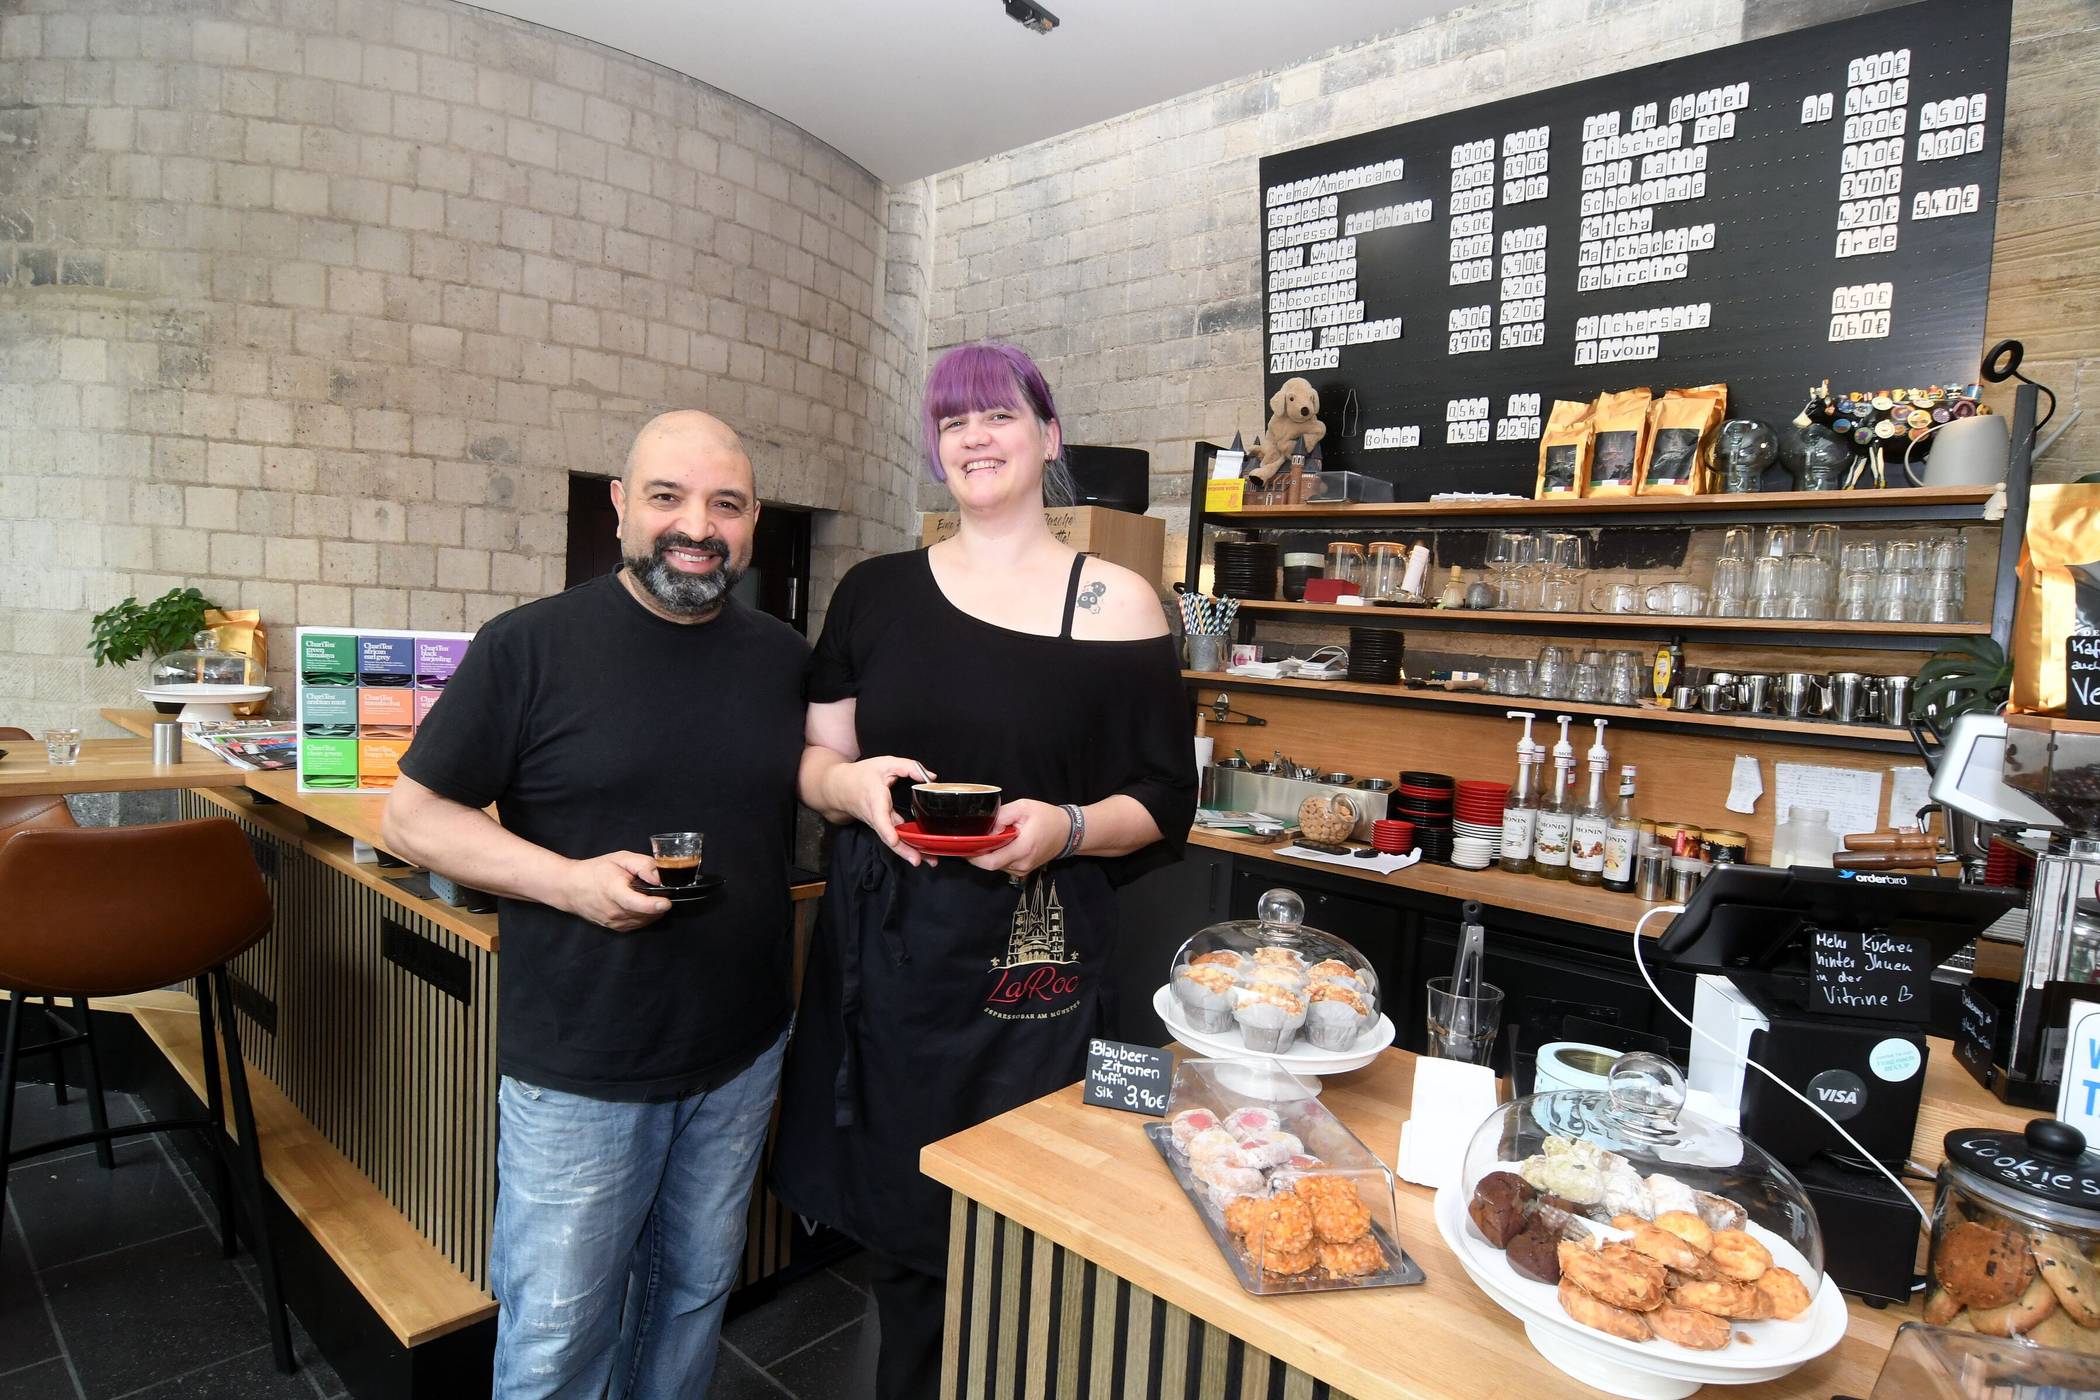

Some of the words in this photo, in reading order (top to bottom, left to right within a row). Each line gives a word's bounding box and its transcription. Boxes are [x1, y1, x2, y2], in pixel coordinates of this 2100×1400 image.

[1850, 57, 1906, 83] 3,90€
[1584, 122, 1618, 138] Tee
[1634, 111, 1656, 126] im
[1671, 90, 1744, 119] Beutel
[1804, 101, 1830, 119] ab
[1848, 86, 1905, 111] 4,40€
[1585, 134, 1680, 156] frischer
[1696, 123, 1731, 139] Tee
[1584, 164, 1628, 182] Chai
[1644, 155, 1704, 175] Latte
[1267, 166, 1402, 204] Crema/Americano
[1583, 181, 1704, 212] Schokolade
[1268, 203, 1337, 226] Espresso
[1269, 226, 1337, 248] Espresso
[1345, 207, 1431, 232] Macchiato
[1581, 218, 1651, 238] Matcha
[1580, 232, 1713, 262] Matchaccino
[1839, 233, 1896, 253] free
[1270, 252, 1302, 268] Flat
[1311, 243, 1354, 261] White
[1270, 266, 1355, 288] Cappuccino
[1580, 263, 1687, 289] Babiccino
[1270, 286, 1356, 309] Chococcino
[1270, 307, 1363, 330] Milchkaffee
[1577, 311, 1707, 336] Milchersatz
[1270, 335, 1312, 352] Latte
[1320, 322, 1401, 345] Macchiato
[1450, 334, 1490, 353] 3,90€
[1501, 327, 1543, 347] 5,90€
[1270, 354, 1339, 372] Affogato
[1365, 434, 1417, 447] Bohnen
[1540, 822, 1568, 830] MONIN
[1575, 826, 1603, 835] MONIN
[1855, 872, 1908, 887] orderbird
[1815, 933, 1847, 950] Mehr
[1861, 932, 1913, 954] Kuchen
[1814, 951, 1856, 968] hinter
[1815, 970, 1828, 982] in
[1837, 970, 1863, 983] der
[1823, 985, 1889, 1007] Vitrine
[1101, 1059, 1160, 1080] Zitronen
[1123, 1084, 1166, 1109] 3,90€
[1815, 1087, 1859, 1105] VISA
[1961, 1138, 2100, 1196] Cookies
